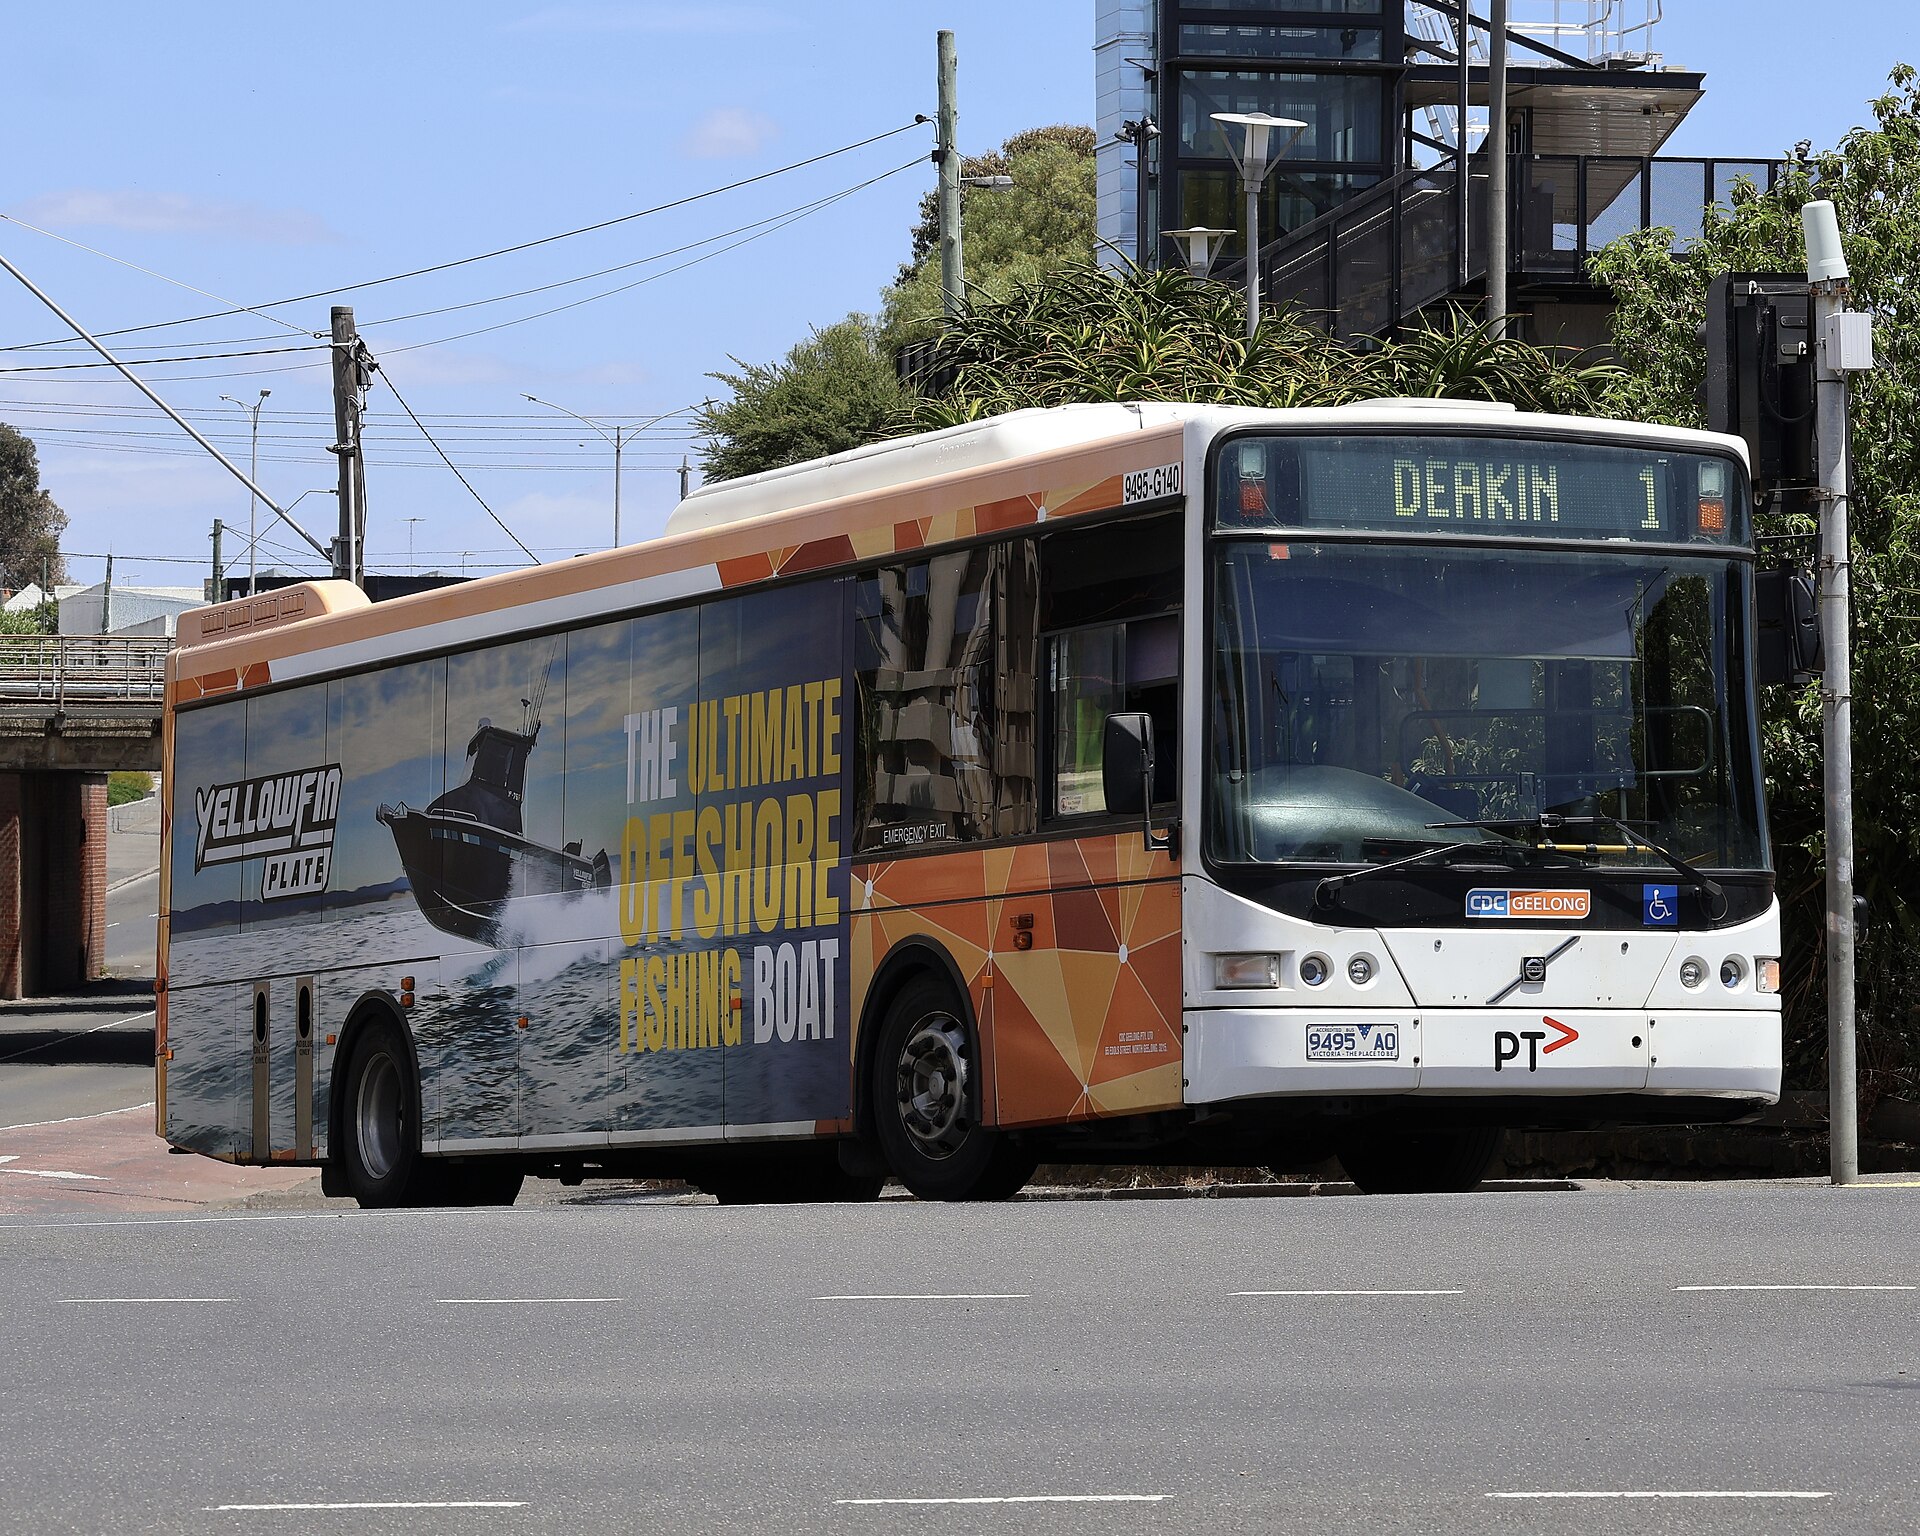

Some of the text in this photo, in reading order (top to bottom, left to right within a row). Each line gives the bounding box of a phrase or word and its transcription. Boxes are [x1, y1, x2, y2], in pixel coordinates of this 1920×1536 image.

[1125, 465, 1179, 502] 9495-G140
[1394, 460, 1659, 529] DEAKIN 1
[623, 678, 841, 804] THE ULTIMATE
[196, 768, 341, 868] YELLOWFIN
[883, 823, 947, 844] EMERGENCY EXIT
[268, 856, 324, 891] PLATE
[619, 789, 840, 947] OFFSHORE
[1470, 895, 1586, 911] CDC GEELONG
[620, 938, 839, 1053] FISHING BOAT
[1309, 1033, 1356, 1051] 9495
